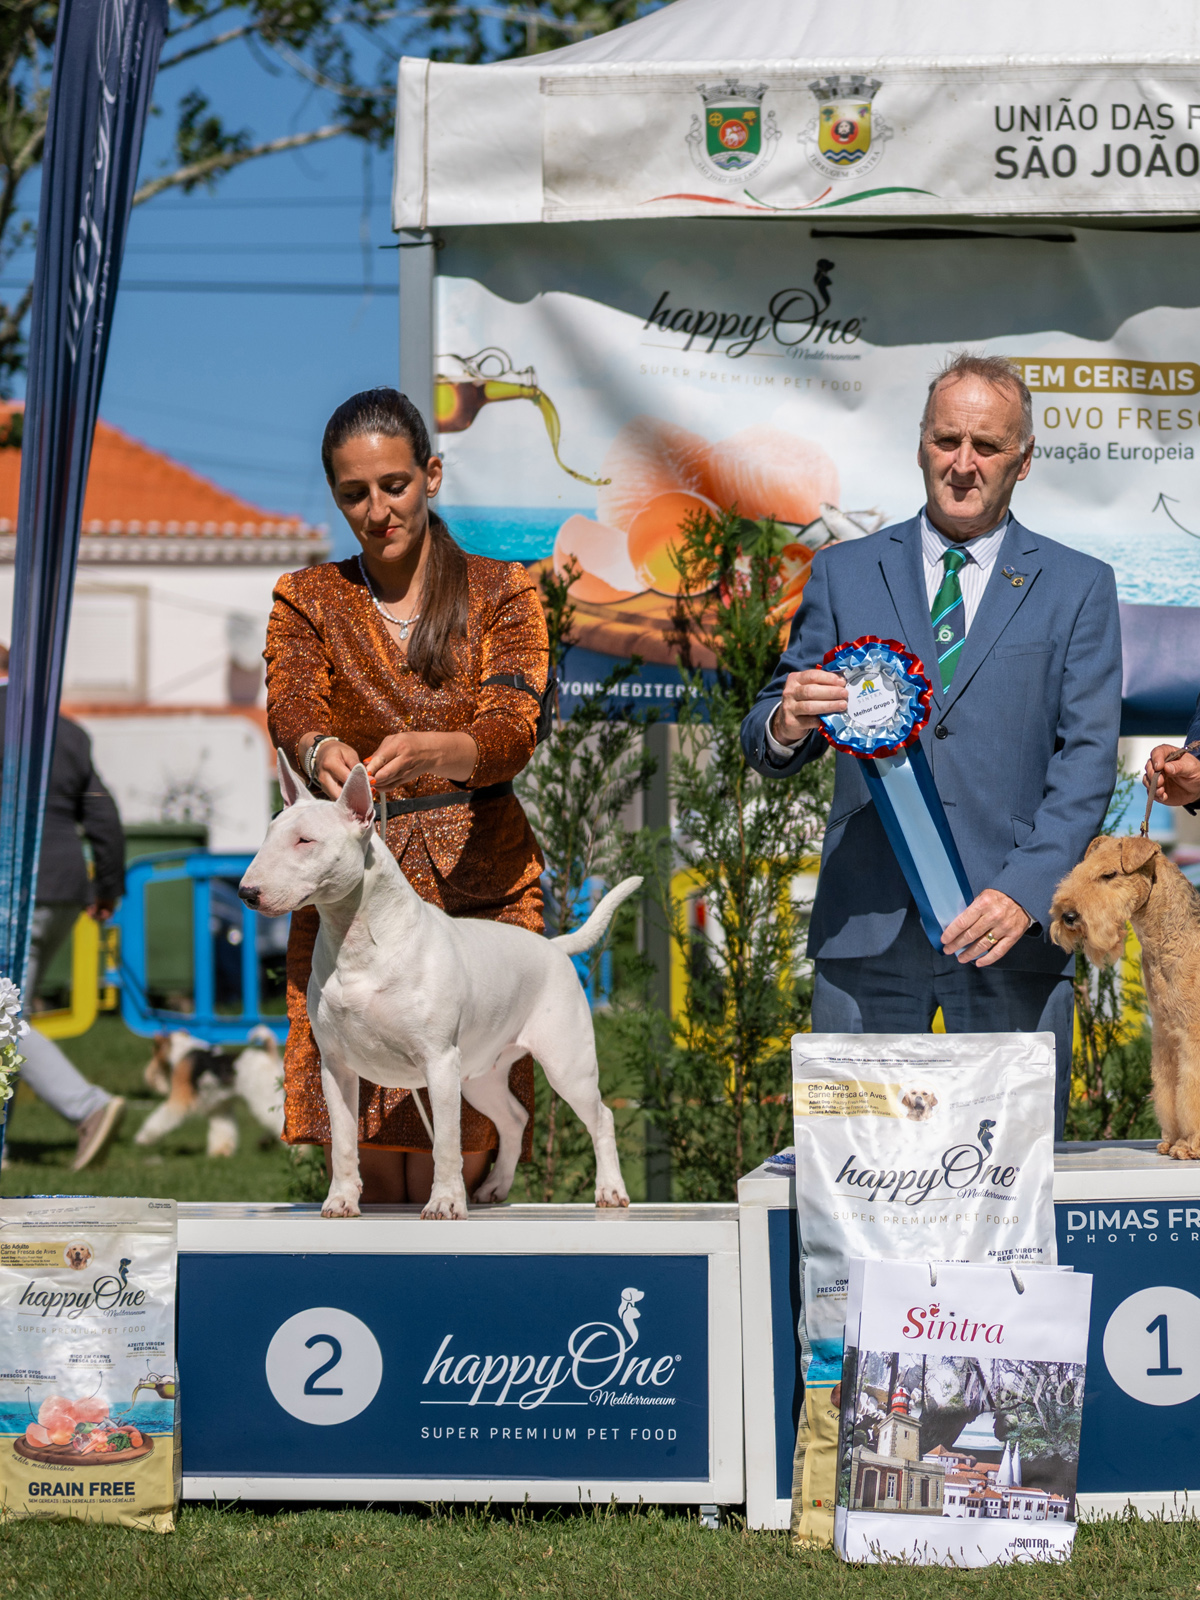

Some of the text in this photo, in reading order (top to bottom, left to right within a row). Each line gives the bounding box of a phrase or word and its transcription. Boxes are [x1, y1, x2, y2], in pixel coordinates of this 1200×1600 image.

[995, 98, 1098, 132] UNIÃO
[1112, 103, 1174, 131] DAS
[809, 150, 881, 178] TERRUGEM SINTRA
[994, 134, 1076, 180] SÃO
[1091, 133, 1199, 178] JOÃO
[639, 364, 862, 392] SUPER PREMIUM PET FOOD
[1073, 365, 1195, 391] CEREAIS
[1043, 406, 1103, 429] OVO
[1032, 442, 1195, 464] ovação Europeia
[853, 707, 873, 717] Melhor
[873, 700, 890, 710] Grupo
[808, 1091, 831, 1099] Carne
[832, 1091, 858, 1099] Fresca
[869, 1092, 887, 1100] Aves
[833, 1211, 1020, 1225] SUPER PREMIUM PET FOOD
[987, 1247, 1043, 1257] AZEITE VIRGEM
[997, 1253, 1034, 1262] REGIONAL
[17, 1325, 47, 1334] SUPER
[52, 1326, 97, 1335] PREMIUM
[123, 1325, 146, 1334] FOOD
[902, 1303, 1005, 1345] Sintra
[1145, 1314, 1183, 1377] 1
[303, 1333, 344, 1396] 2
[588, 1389, 677, 1407] Mediterraneum
[421, 1426, 678, 1441] SUPER PREMIUM PET FOOD
[28, 1481, 136, 1497] GRAIN FREE
